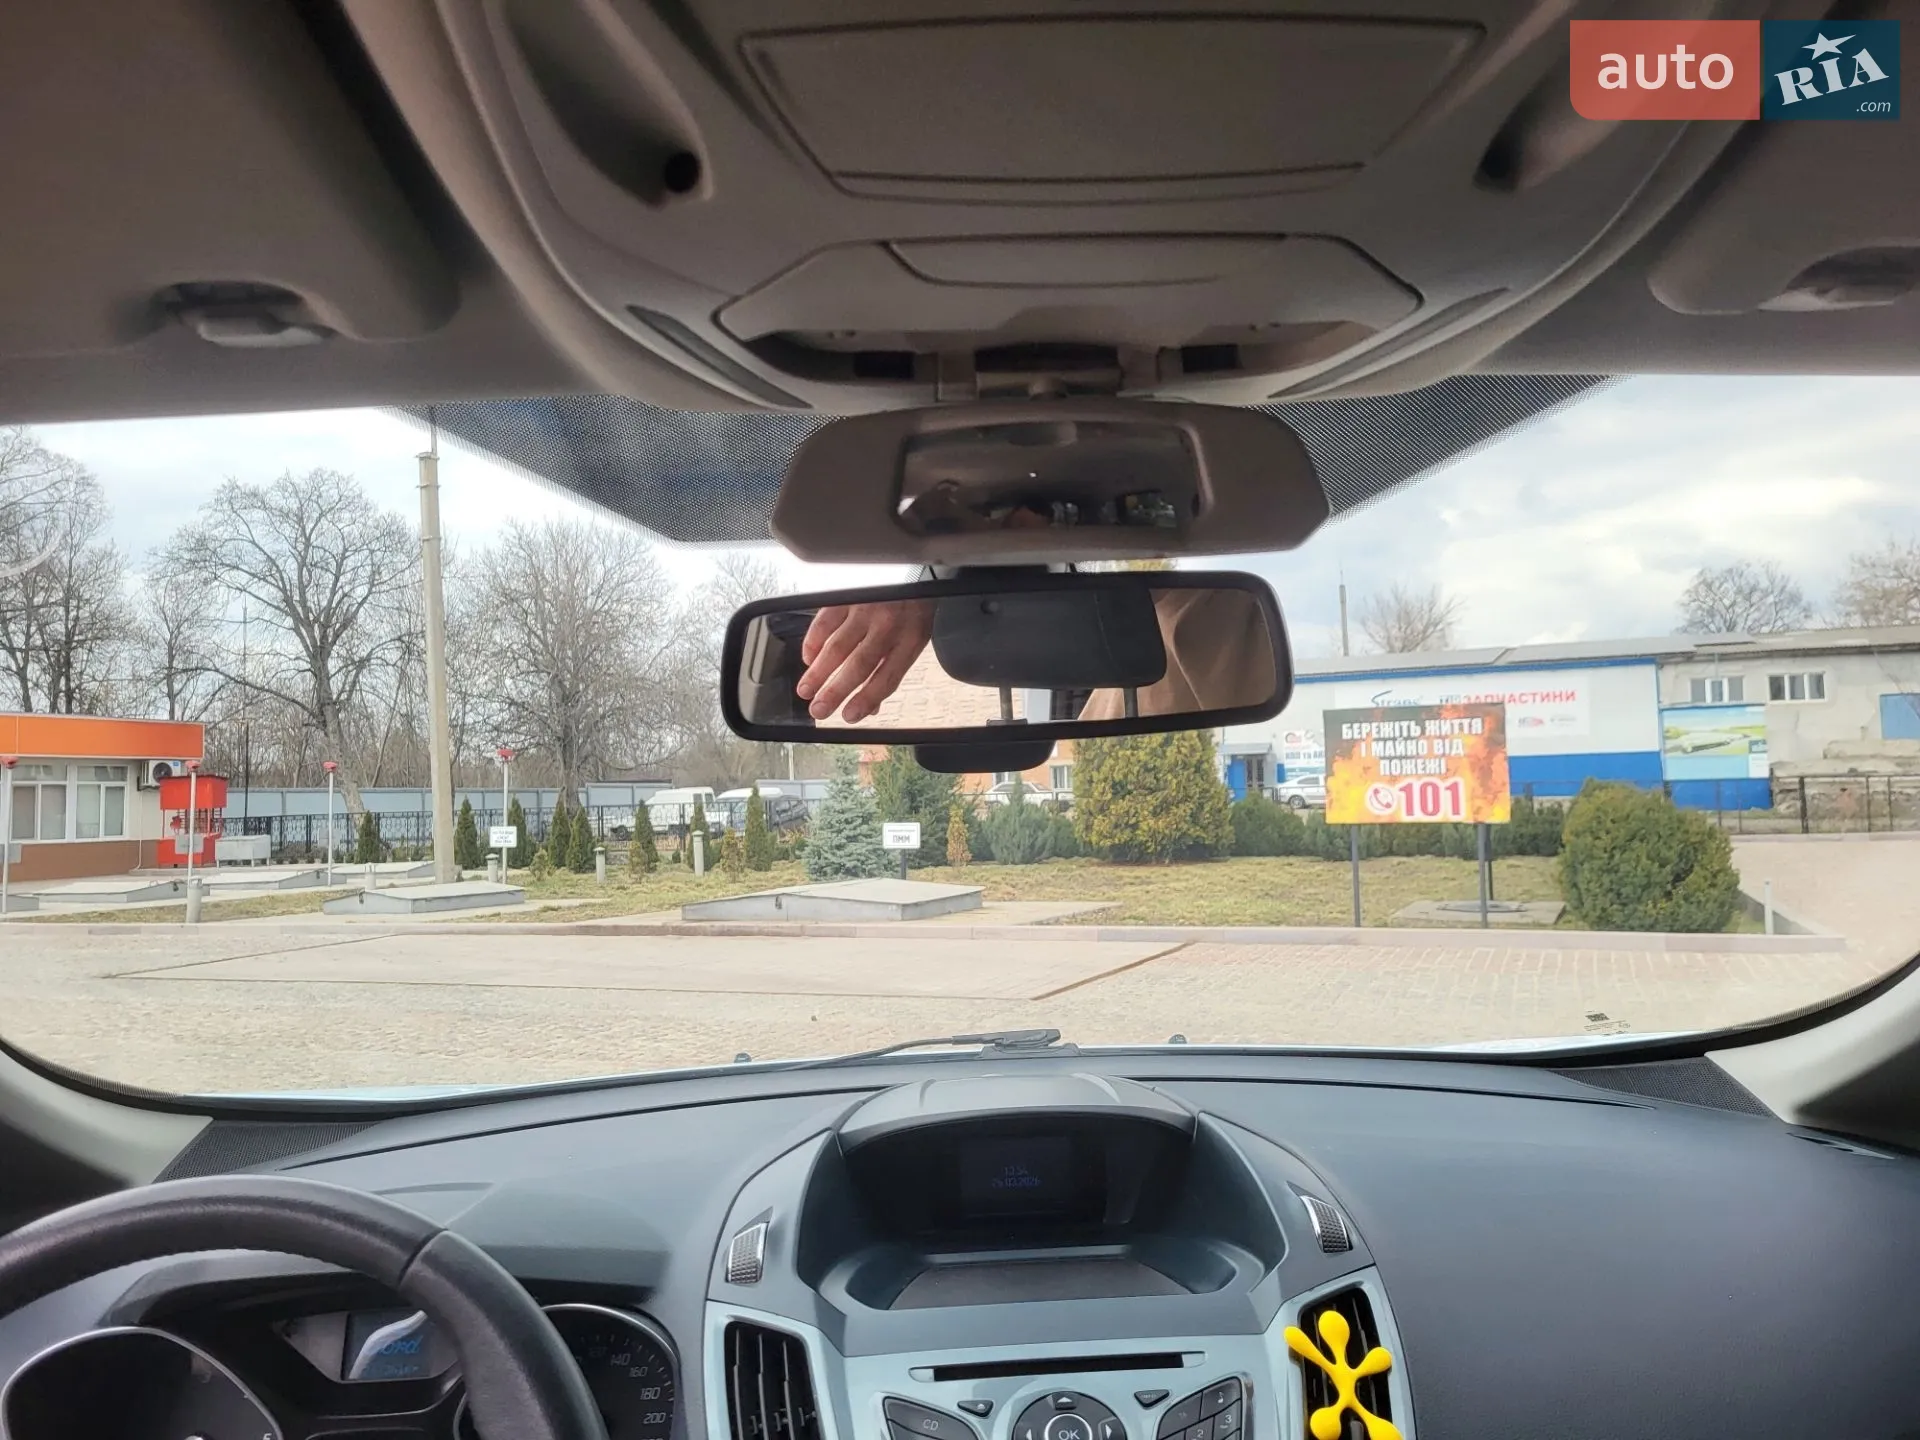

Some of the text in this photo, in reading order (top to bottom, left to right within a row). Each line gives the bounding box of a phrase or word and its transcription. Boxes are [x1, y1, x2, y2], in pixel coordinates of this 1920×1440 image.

[1342, 718, 1483, 739] БЕРЕЖІТЬ ЖИТТЯ
[1360, 738, 1464, 757] І МАЙНО ВІД
[1380, 758, 1446, 775] ПОЖЕЖІ
[1398, 781, 1462, 817] 101
[610, 1353, 630, 1366] 140
[629, 1366, 648, 1378] 160
[640, 1387, 660, 1400] 180
[643, 1412, 666, 1425] 200
[922, 1418, 939, 1431] CD
[1225, 1414, 1232, 1424] 3
[1058, 1429, 1080, 1440] OK
[1197, 1429, 1204, 1438] 2
